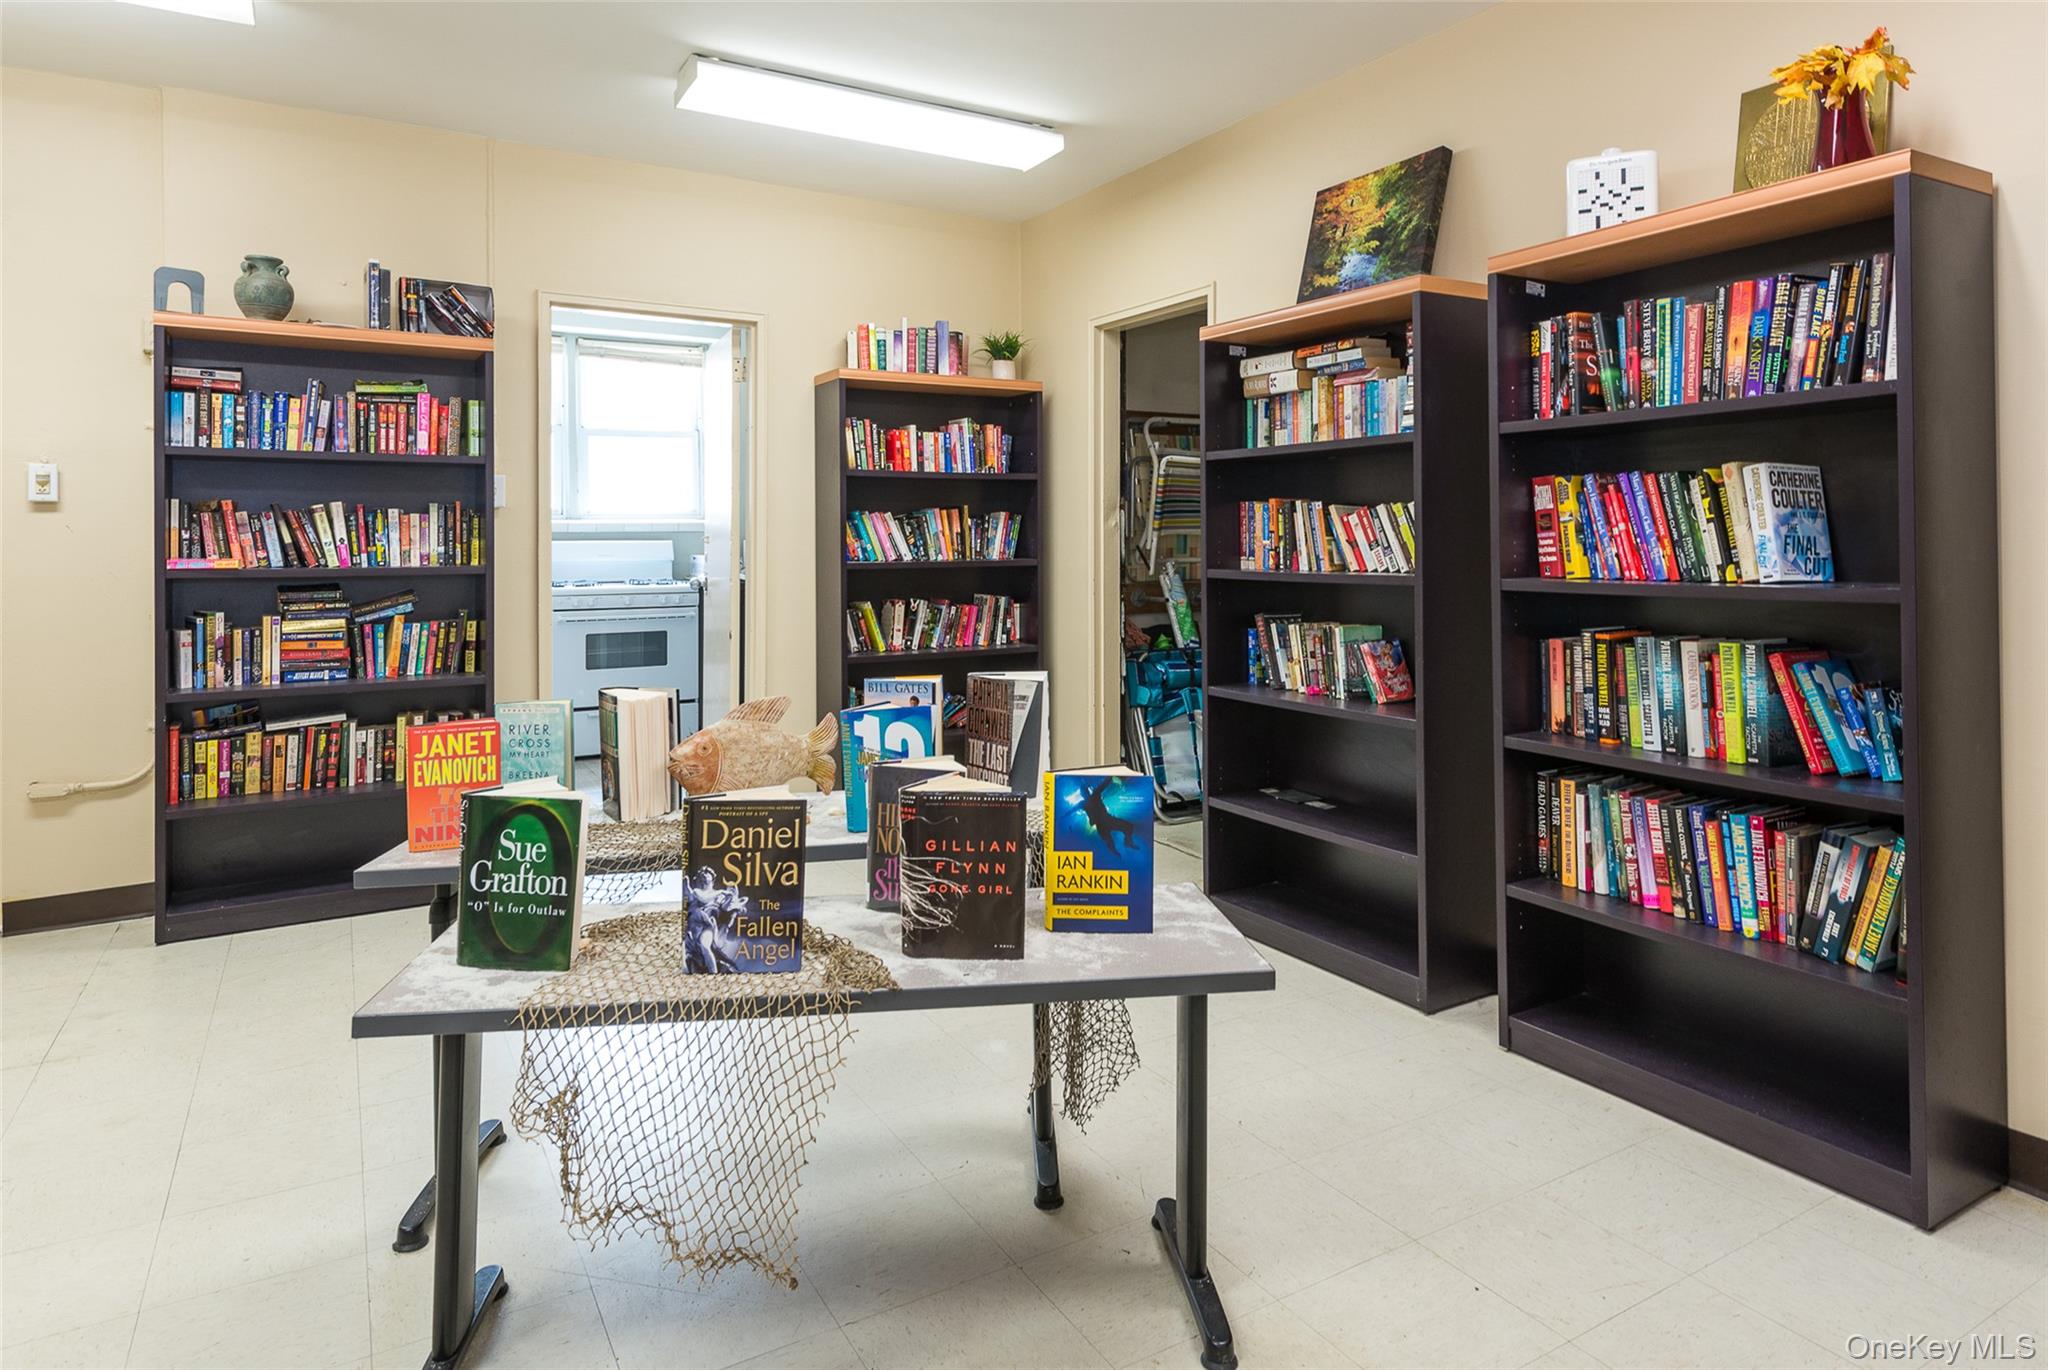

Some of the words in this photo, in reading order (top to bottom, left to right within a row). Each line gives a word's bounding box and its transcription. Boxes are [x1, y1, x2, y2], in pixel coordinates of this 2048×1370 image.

[1774, 281, 1791, 305] DAN
[1813, 287, 1827, 313] BONE
[1643, 302, 1651, 328] STEVE
[1753, 315, 1766, 342] DARK
[1769, 306, 1788, 347] BROWN
[1810, 314, 1822, 338] LAKE
[1643, 329, 1652, 358] BERRY
[1673, 314, 1682, 358] POSTMISTRESS
[1749, 348, 1763, 382] NIGHT
[1763, 351, 1774, 384] FORTRESS
[1771, 351, 1783, 385] DIGITAL
[199, 393, 208, 411] STEVE
[1751, 466, 1765, 502] CATHERINE
[1769, 471, 1821, 491] CATHERINE
[1647, 475, 1655, 494] MARY
[1657, 518, 1666, 537] CLARK
[1659, 474, 1667, 493] MARY
[1663, 493, 1673, 520] HIGGINS
[1669, 520, 1679, 541] CLARK
[1718, 487, 1731, 515] PATRICIA
[1772, 488, 1824, 511] COULTER
[1756, 502, 1767, 530] COULTER
[1787, 522, 1799, 534] THE
[1724, 515, 1738, 548] CORNWELL
[1758, 534, 1768, 554] FINAL
[1374, 549, 1386, 570] ESCAPE
[1784, 535, 1820, 557] FINAL
[1759, 555, 1768, 569] CUT
[1804, 556, 1829, 580] CUT
[1584, 633, 1593, 659] PATRICIA
[1597, 644, 1607, 672] PATRICIA
[1639, 641, 1649, 669] PATRICIA
[1660, 641, 1671, 672] PATRICIA
[1585, 659, 1593, 687] CORNWELL
[1687, 650, 1699, 682] CATHERINE
[1723, 646, 1735, 677] PATRICIA
[1745, 645, 1756, 678] PATRICIA
[867, 682, 892, 694] BILL
[894, 683, 930, 695] GATES
[971, 679, 1009, 712] PATRICIA
[1598, 672, 1609, 706] CORNWELL
[1640, 670, 1650, 701] CORNWELL
[1663, 673, 1675, 711] CORNWELL
[1689, 683, 1700, 711] COOKSON
[1725, 677, 1737, 713] CORNWELL
[1747, 679, 1758, 719] CORNWELL
[1642, 703, 1655, 737] SCARPETTA
[1798, 671, 1814, 696] JANET
[1807, 696, 1828, 742] EVANOVICH
[508, 724, 551, 736] RIVER
[841, 721, 851, 746] JANET
[967, 706, 1009, 742] CORNWELL
[1667, 714, 1675, 746] SCARPETTA
[414, 731, 497, 759] JANET
[508, 738, 551, 749] CROSS
[1751, 723, 1759, 755] SCARPETTA
[509, 751, 522, 759] MY
[523, 750, 551, 760] HEART
[969, 738, 985, 768] THE
[985, 742, 1009, 774] LAST
[1864, 750, 1877, 774] MARTIN
[1871, 754, 1880, 767] KAT
[413, 755, 497, 788] EVANOVICH
[508, 770, 550, 781] BREENA
[843, 748, 853, 798] EVANOVICH
[1537, 780, 1546, 806] HEAD
[1620, 795, 1632, 812] JUDE
[1537, 806, 1548, 838] GAMES
[1551, 796, 1561, 826] DEAVER
[1633, 800, 1643, 816] JUDE
[1647, 801, 1659, 830] JEFFERY
[1660, 809, 1669, 827] RODDY
[1675, 809, 1685, 834] DAMAGE
[1692, 810, 1703, 830] Janet
[498, 829, 547, 863] Sue
[701, 817, 801, 849] Daniel
[925, 839, 1018, 853] GILLIAN
[1636, 816, 1646, 849] DEVERAUX
[1650, 830, 1664, 855] DEAVER
[1663, 827, 1672, 844] DOYLE
[1695, 830, 1708, 862] Evanovich
[1731, 823, 1749, 854] JANET
[1751, 829, 1764, 854] JANET
[1678, 833, 1689, 861] CONTROL
[1775, 844, 1785, 866] JANET
[1889, 851, 1899, 870] PLUM
[722, 852, 799, 886] Silva
[935, 861, 1007, 875] FLYNN
[1057, 855, 1087, 870] IAN
[1654, 855, 1671, 884] EDGE
[1698, 864, 1709, 887] Wicked
[1894, 850, 1905, 877] SPOOKY
[469, 860, 568, 897] Grafton
[928, 884, 971, 894] GONE
[977, 884, 1014, 895] GIRL
[1056, 875, 1123, 890] RANKIN
[1684, 874, 1692, 893] Robert
[1734, 856, 1754, 909] EVANOVICH
[1753, 855, 1769, 902] EVANOVICH
[1777, 867, 1788, 911] EVANOVICH
[493, 902, 503, 913] Is
[506, 902, 523, 914] for
[527, 903, 567, 917] Outlaw
[759, 899, 781, 911] The
[1056, 908, 1071, 916] THE
[1073, 908, 1125, 917] COMPLAINTS
[1702, 887, 1713, 914] Business
[1871, 875, 1899, 927] EVANOVICH
[736, 915, 798, 937] Fallen
[1831, 922, 1841, 938] KURT
[735, 938, 796, 965] Angel
[1862, 927, 1881, 956] JANET
